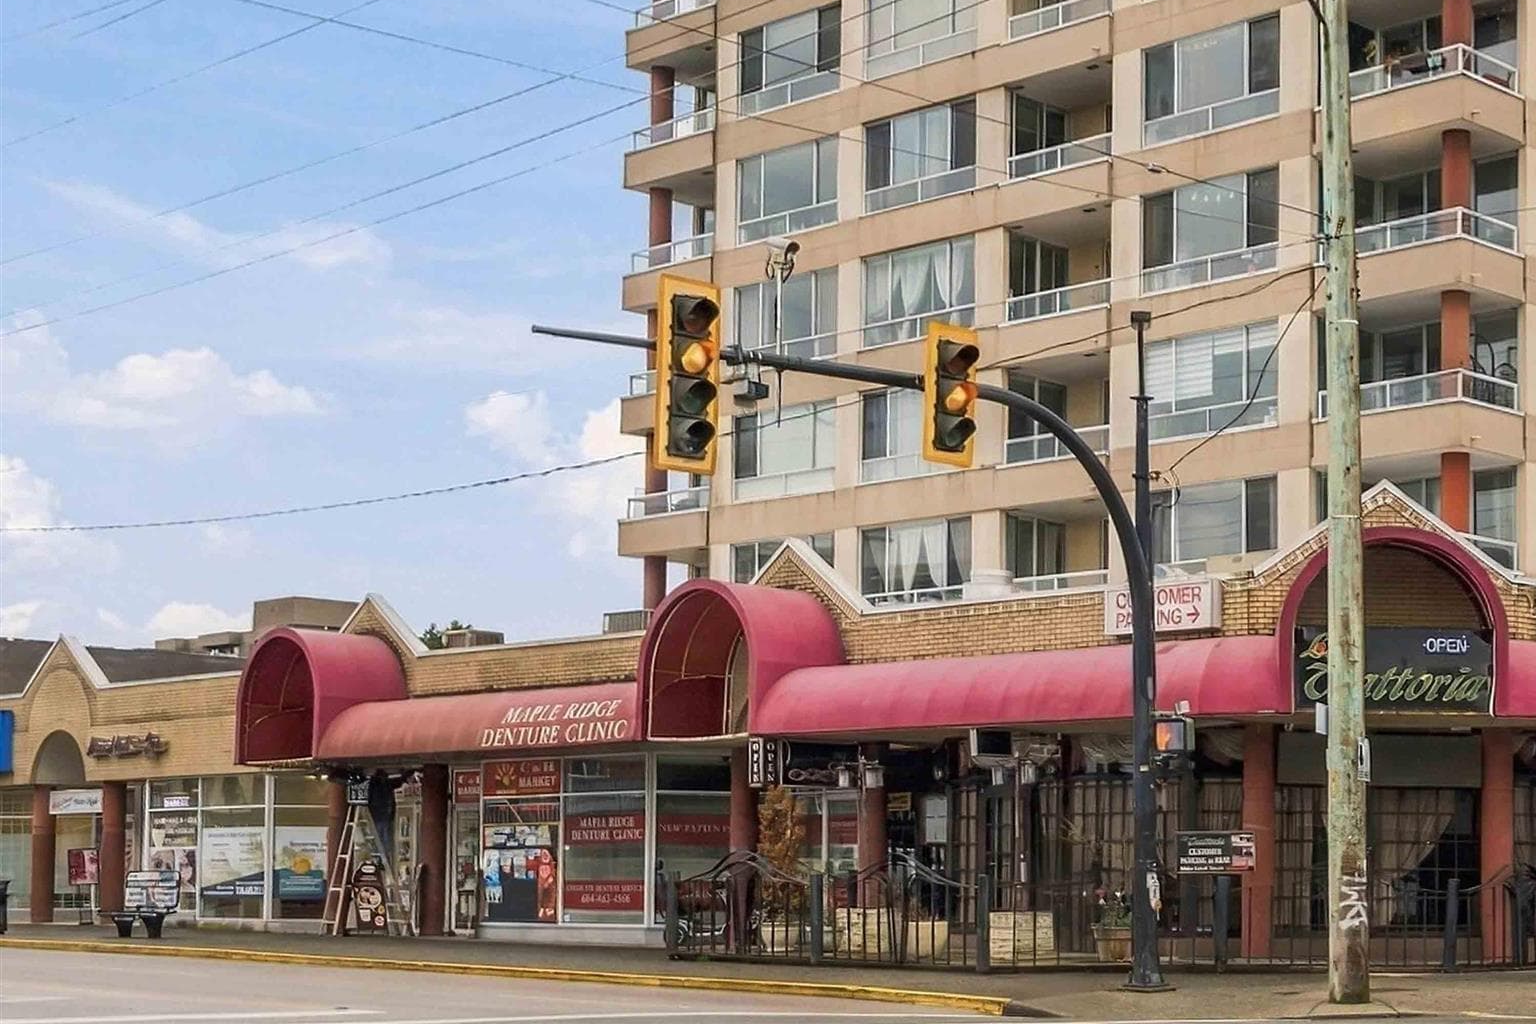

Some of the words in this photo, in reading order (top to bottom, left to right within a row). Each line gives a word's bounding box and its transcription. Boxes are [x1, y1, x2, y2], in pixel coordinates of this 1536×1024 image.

[1116, 586, 1201, 609] COMER
[1116, 608, 1182, 629] PAING
[1425, 637, 1468, 653] OPEN
[501, 704, 563, 725] MAPLE
[563, 699, 622, 720] RIDGE
[481, 725, 561, 748] DENTURE
[565, 719, 628, 743] CLINIC
[752, 742, 760, 783] OPEN
[766, 742, 776, 782] OPEN
[518, 775, 557, 788] MARKET
[608, 816, 635, 828] RIDGE
[613, 828, 643, 839] CLINIC
